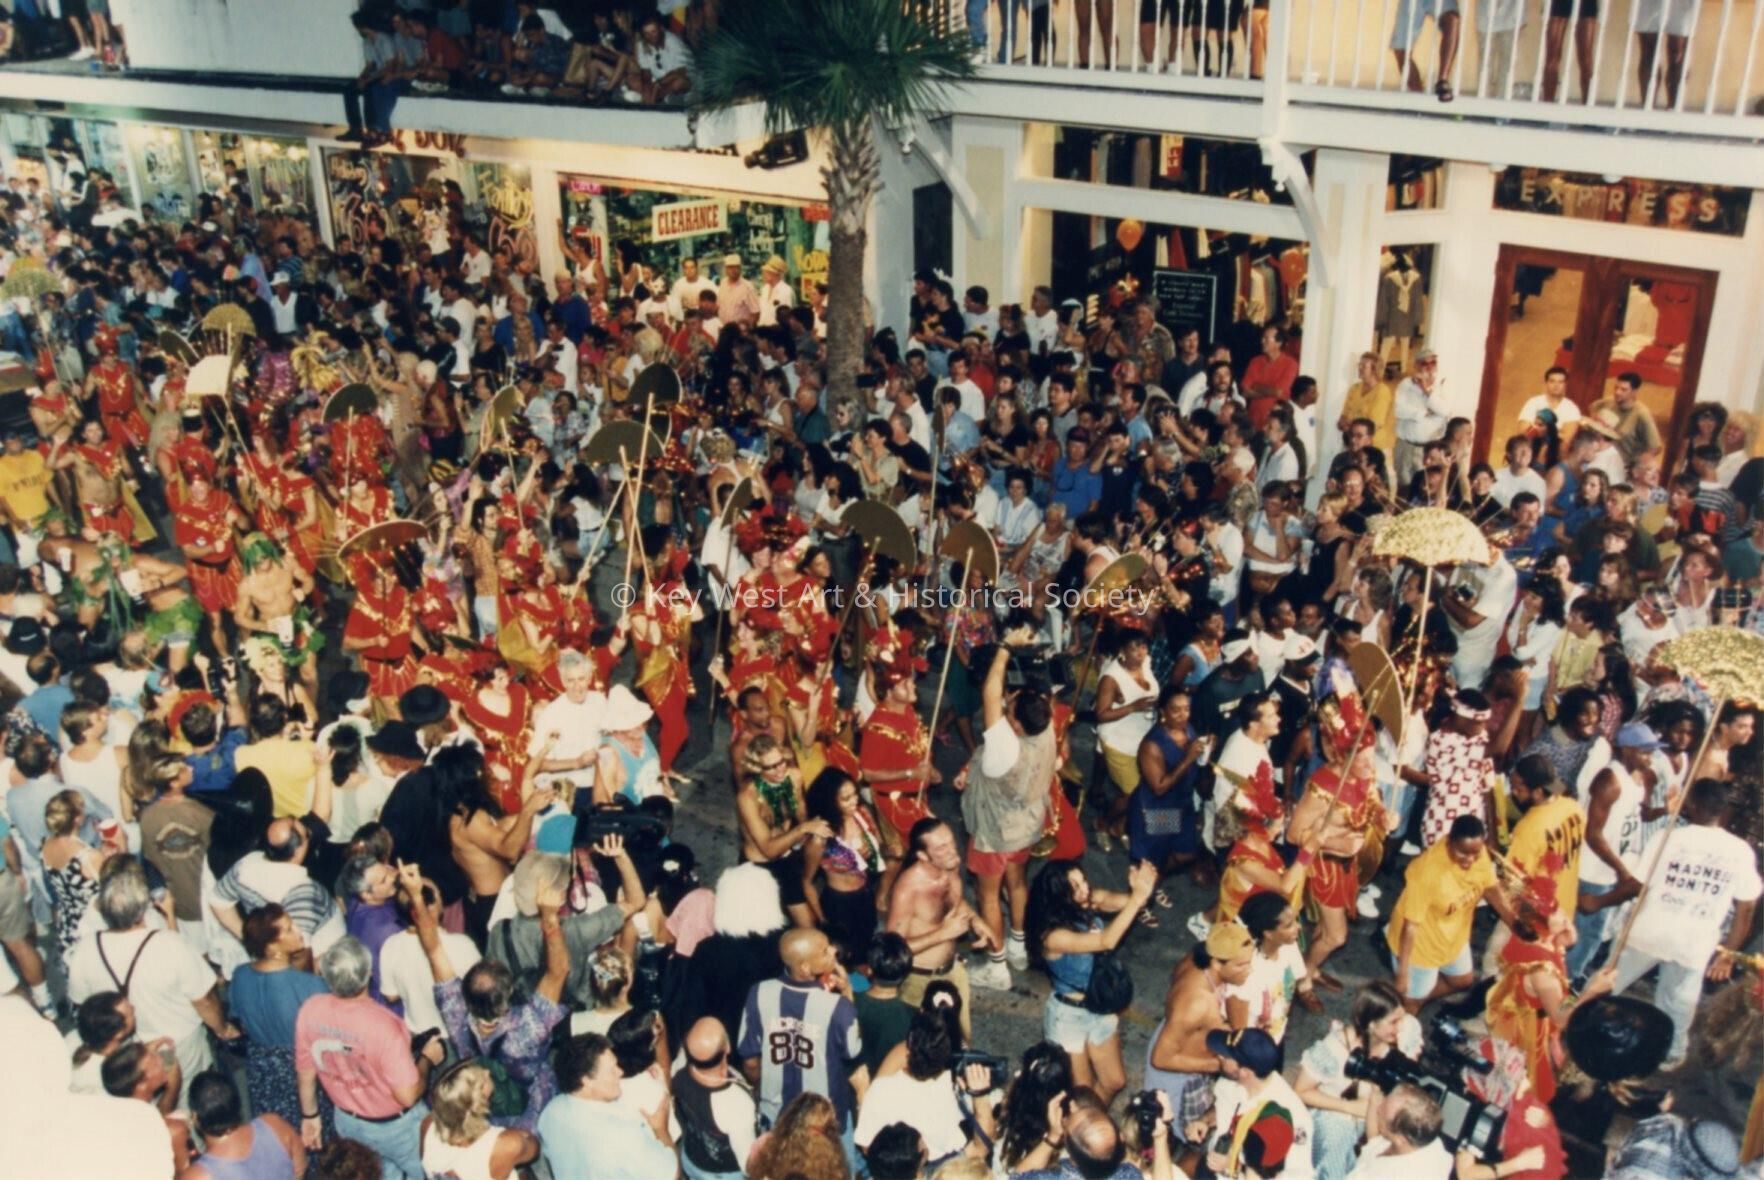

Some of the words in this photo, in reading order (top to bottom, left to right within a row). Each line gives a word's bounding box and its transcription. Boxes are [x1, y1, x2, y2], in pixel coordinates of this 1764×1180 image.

[656, 203, 720, 237] CLEARANCE
[1519, 178, 1720, 223] EXPRESS
[768, 1030, 814, 1070] 88
